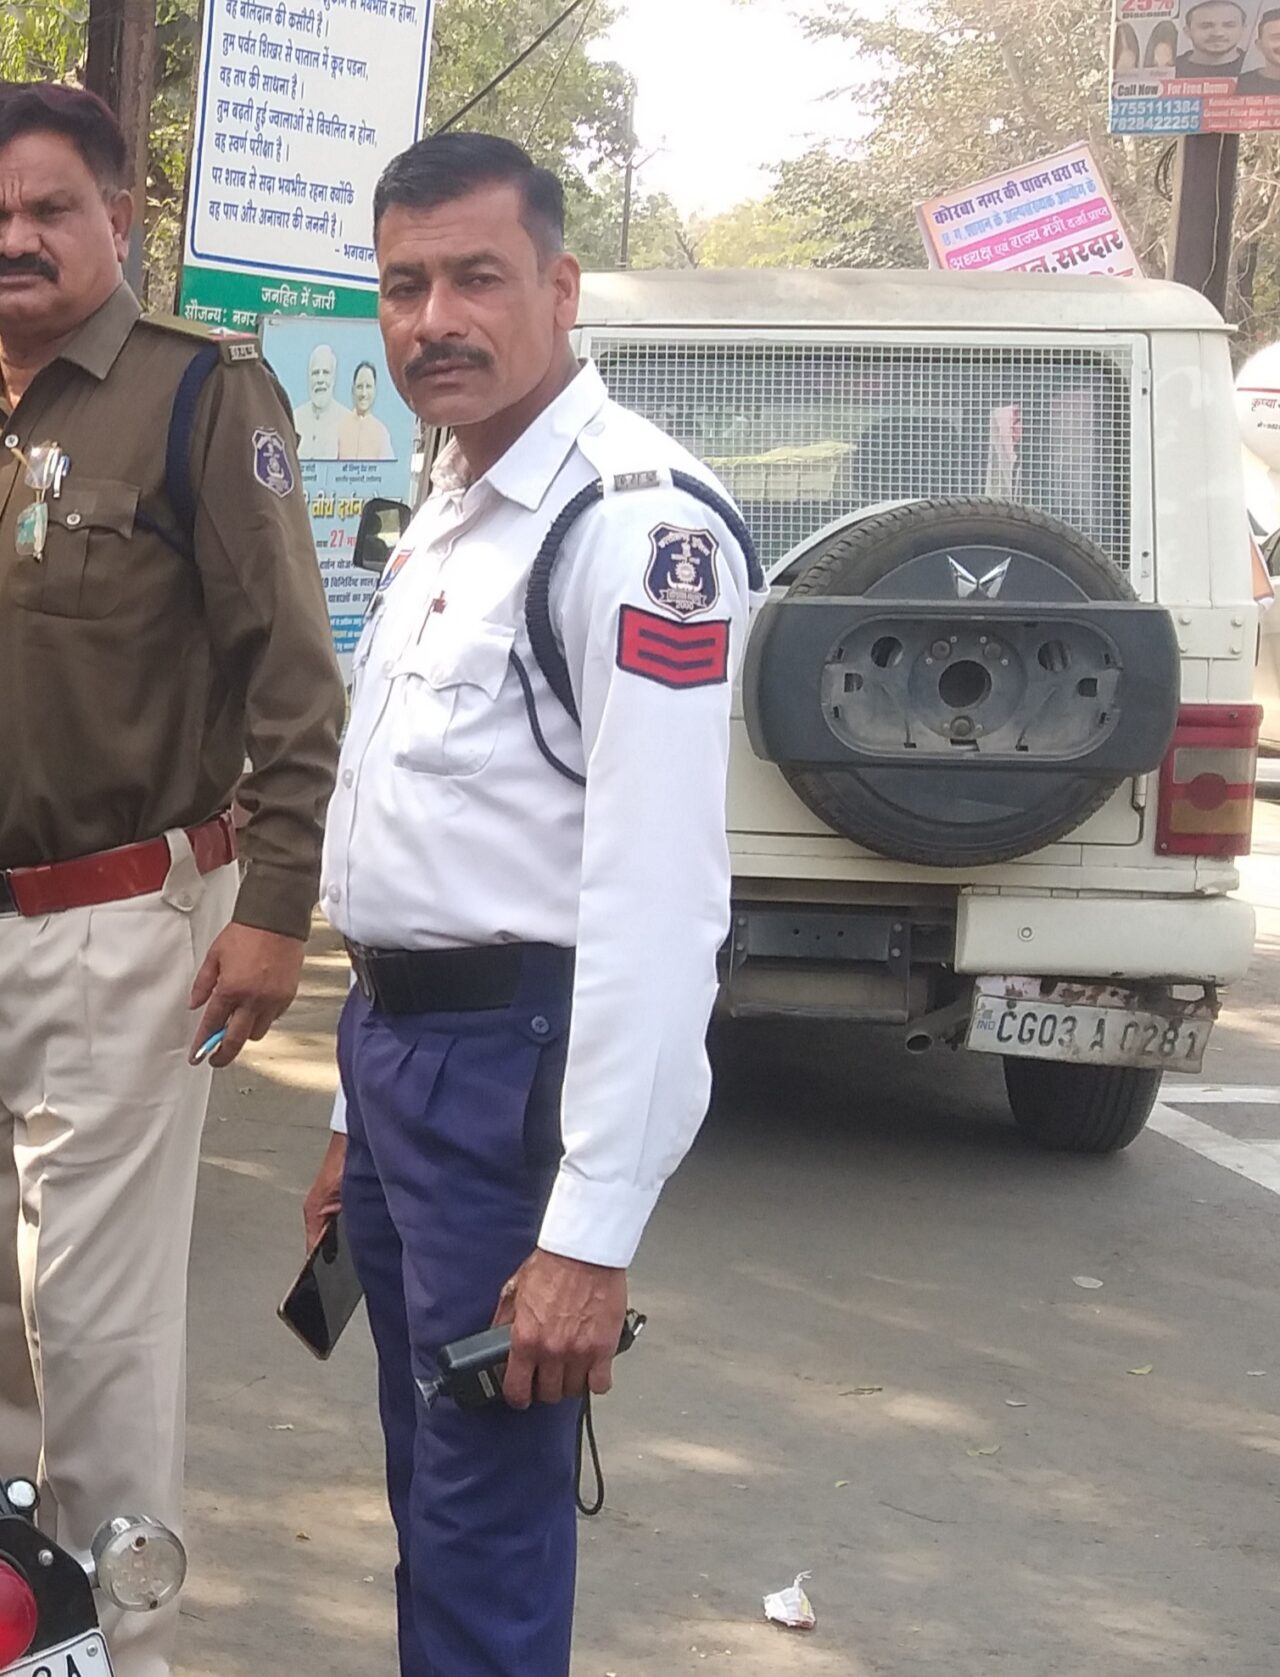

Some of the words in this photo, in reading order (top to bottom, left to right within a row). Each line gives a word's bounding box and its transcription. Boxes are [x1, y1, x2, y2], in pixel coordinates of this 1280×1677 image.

[275, 2, 287, 27] की
[222, 32, 236, 56] तुम
[238, 30, 257, 54] पर्वत
[259, 33, 283, 62] शिखर
[285, 39, 293, 63] से
[295, 48, 320, 68] पाताल
[321, 46, 329, 70] में
[331, 55, 344, 79] कूद
[219, 66, 232, 87] वह
[233, 68, 246, 88] तप
[249, 65, 261, 90] की
[262, 74, 290, 97] साधना
[1118, 83, 1136, 97] Call
[1138, 83, 1159, 96] Now
[217, 98, 230, 123] तुम
[254, 101, 268, 132] हुई
[306, 109, 314, 135] से
[316, 111, 347, 140] विचलित
[349, 125, 357, 143] न
[214, 132, 227, 154] वह
[228, 130, 249, 155] स्वर्ण
[250, 132, 274, 160] परीक्षा
[212, 166, 223, 185] पर
[225, 168, 247, 188] शराब
[248, 165, 257, 190] से
[259, 174, 276, 195] सदा
[278, 173, 307, 198] भयभीत
[309, 183, 328, 203] रहना
[330, 180, 355, 206] क्योंकि
[932, 199, 975, 225] कोरबा
[976, 190, 1005, 209] नगर
[1002, 180, 1020, 200] की
[1020, 171, 1052, 194] पावन
[1050, 162, 1072, 183] धरा
[1071, 158, 1090, 178] पर
[208, 200, 221, 221] वह
[223, 203, 239, 222] पाप
[241, 198, 257, 225] और
[259, 207, 291, 230] अनाचार
[292, 206, 304, 231] की
[305, 210, 329, 236] जननी
[343, 243, 375, 263] भगवान
[261, 283, 298, 307] जनहित
[300, 287, 311, 307] में
[312, 289, 336, 311] जारी
[232, 310, 257, 326] नगर
[330, 529, 345, 548] 27
[976, 1020, 996, 1031] IND
[996, 1010, 1078, 1049] CG03
